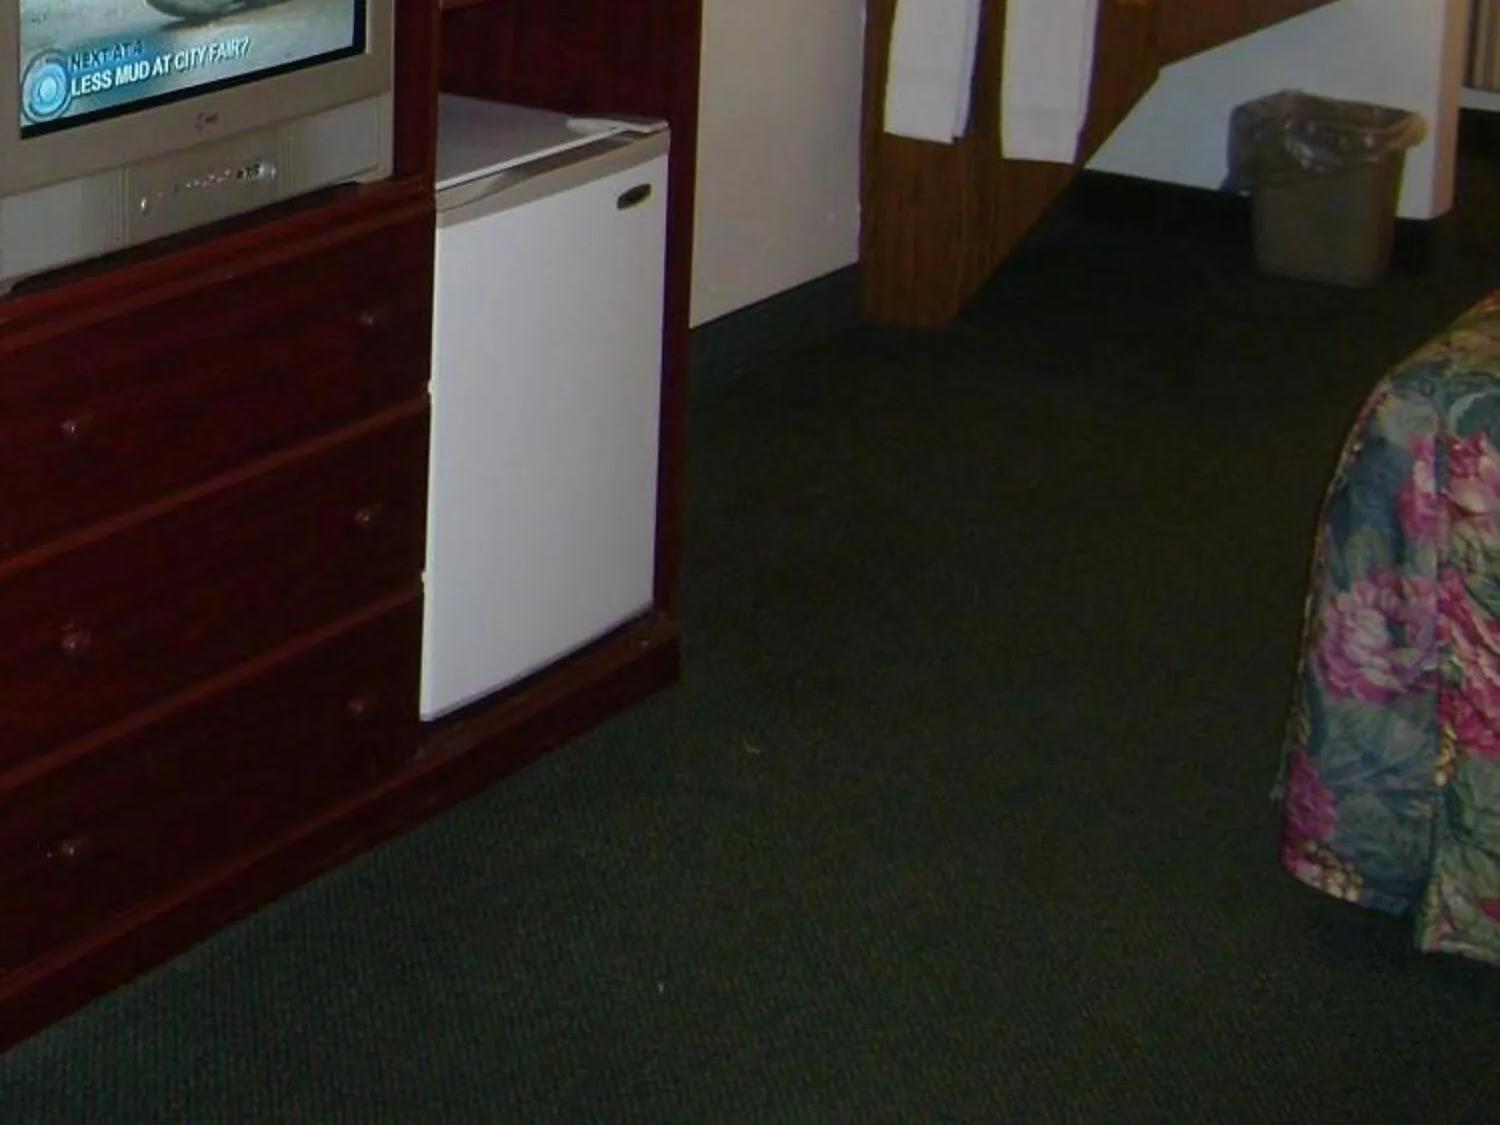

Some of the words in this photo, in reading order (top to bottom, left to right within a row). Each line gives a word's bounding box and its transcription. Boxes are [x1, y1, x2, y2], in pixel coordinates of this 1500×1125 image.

[71, 70, 113, 96] LESS
[115, 61, 150, 87] MUD
[152, 55, 171, 76] AT
[175, 45, 207, 71] CITY
[209, 36, 251, 62] FAIR?
